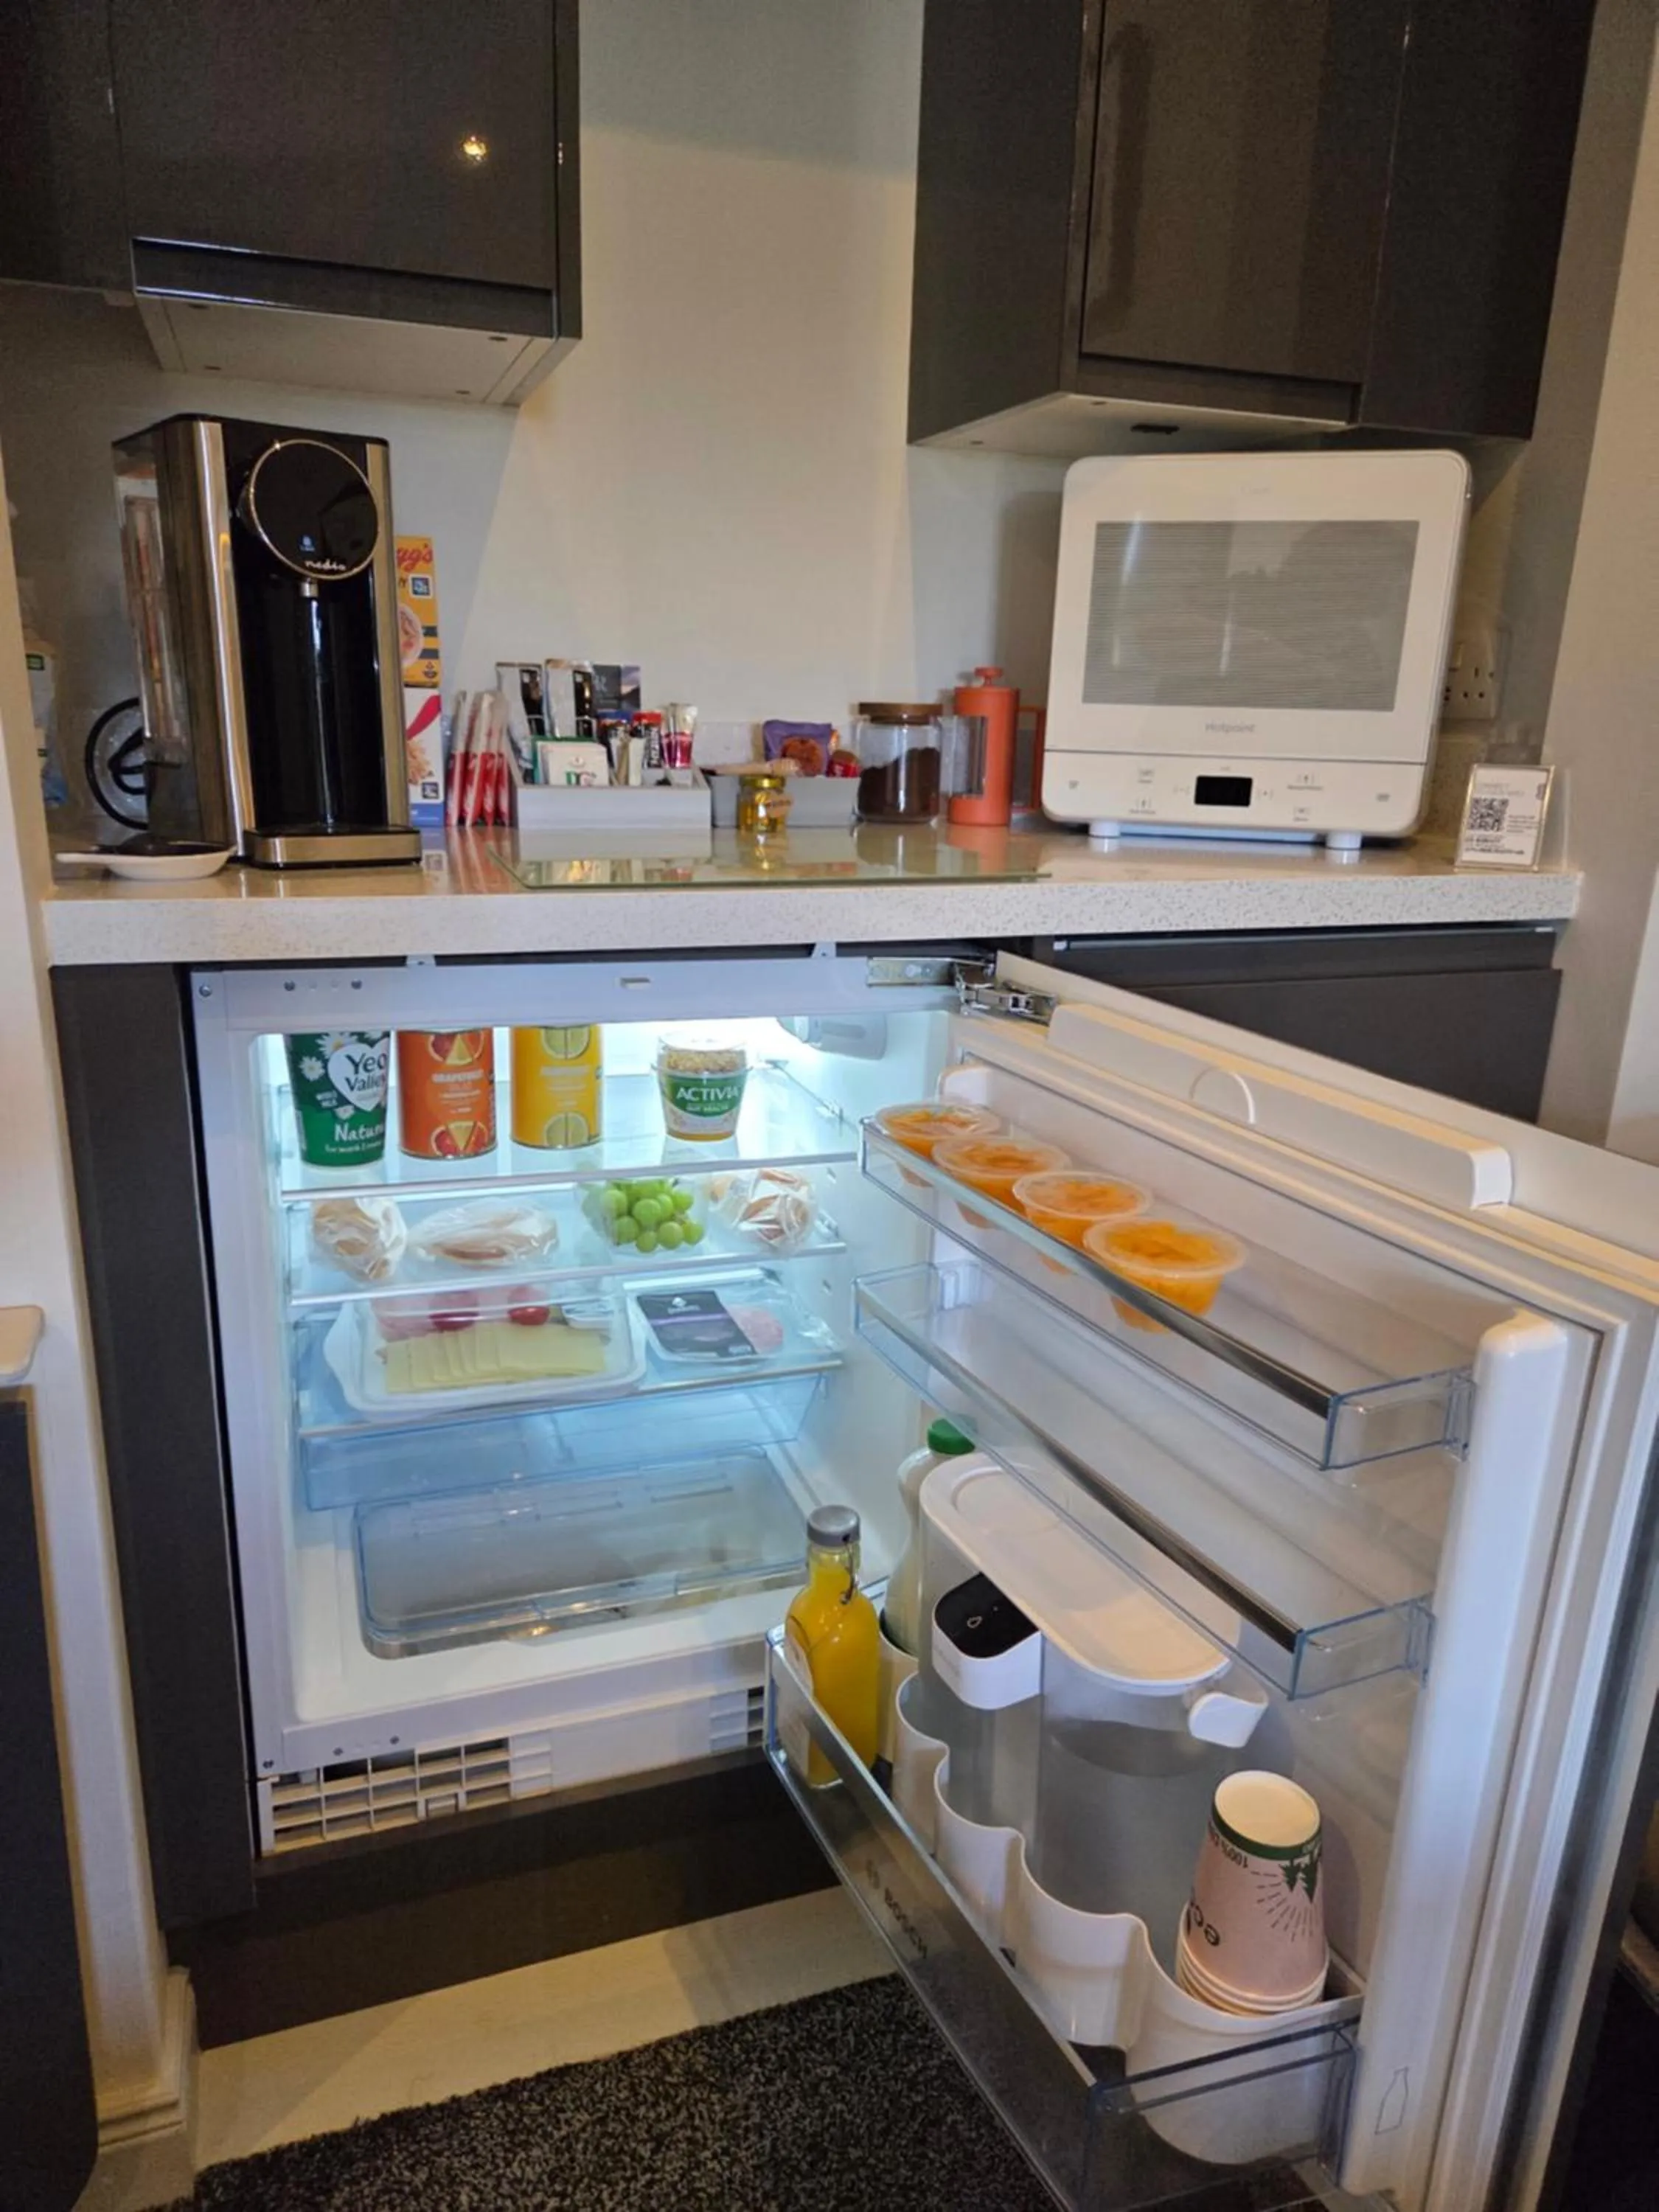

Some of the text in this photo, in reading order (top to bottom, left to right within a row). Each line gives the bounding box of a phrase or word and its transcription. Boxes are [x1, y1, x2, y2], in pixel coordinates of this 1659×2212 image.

[1204, 721, 1256, 734] Hotpoint
[345, 1053, 388, 1075] Yeo
[675, 1086, 740, 1102] ACTIVIA
[334, 1121, 384, 1142] Natur
